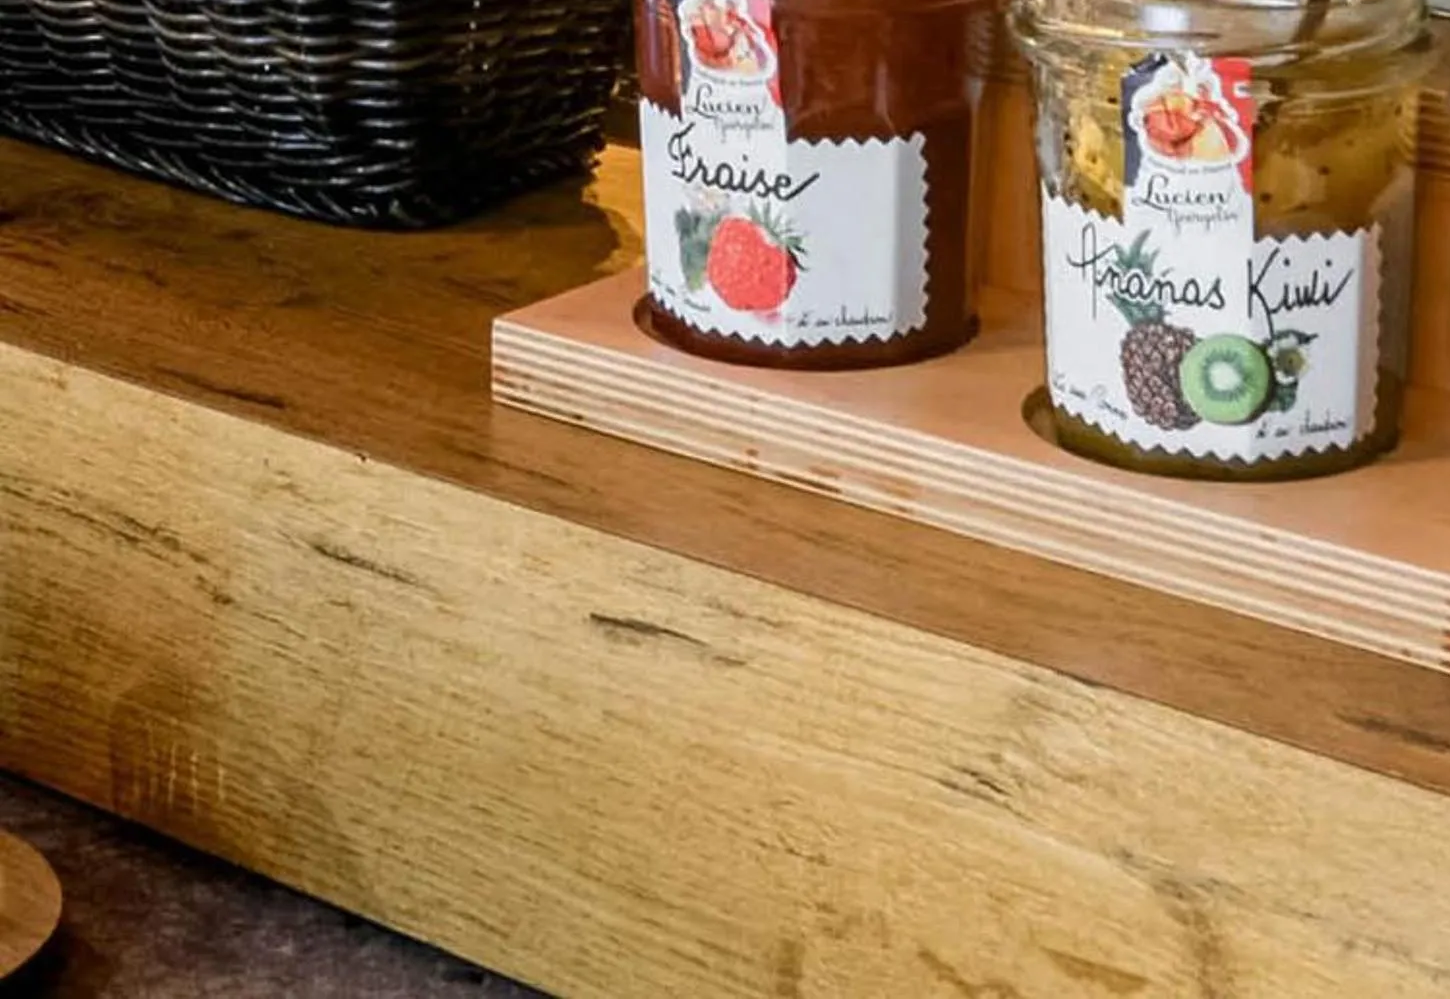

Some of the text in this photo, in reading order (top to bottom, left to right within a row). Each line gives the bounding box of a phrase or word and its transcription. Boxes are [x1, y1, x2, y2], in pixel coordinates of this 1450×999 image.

[686, 83, 766, 119] Lucien
[668, 122, 820, 201] Fraise
[1131, 172, 1230, 213] Lucien
[1066, 222, 1355, 340] Ananas Kiwi
